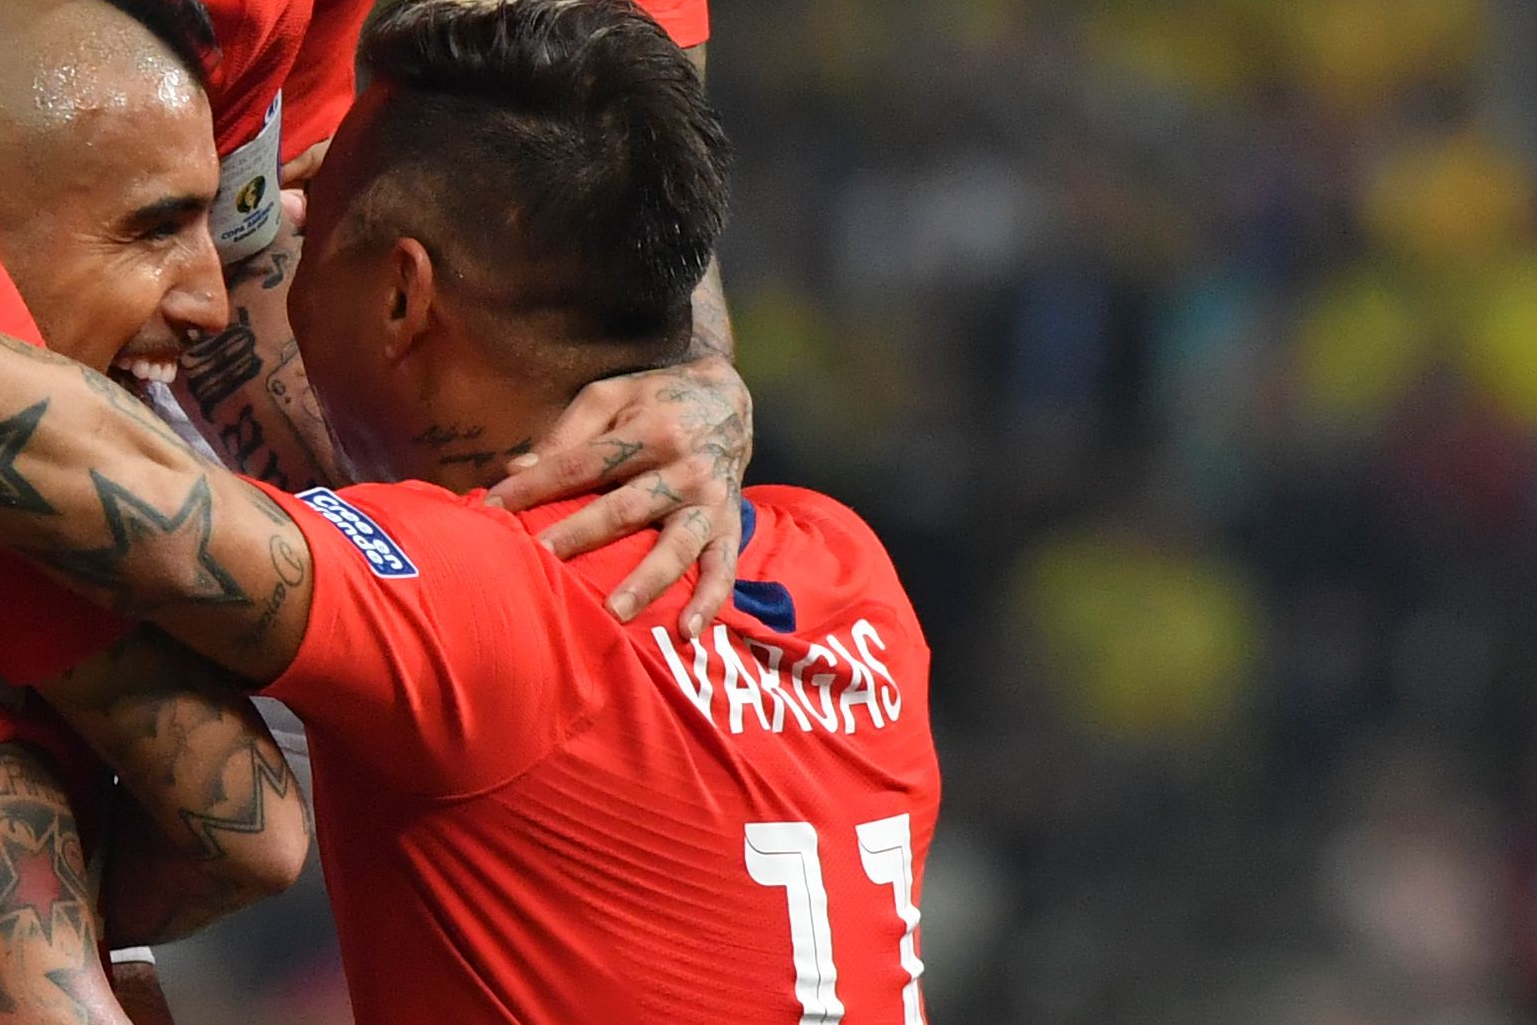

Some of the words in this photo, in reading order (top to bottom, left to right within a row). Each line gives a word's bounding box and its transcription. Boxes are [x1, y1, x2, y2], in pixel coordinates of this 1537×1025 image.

[372, 538, 404, 570] en
[650, 618, 903, 735] VARGAS
[744, 812, 925, 1025] 11
